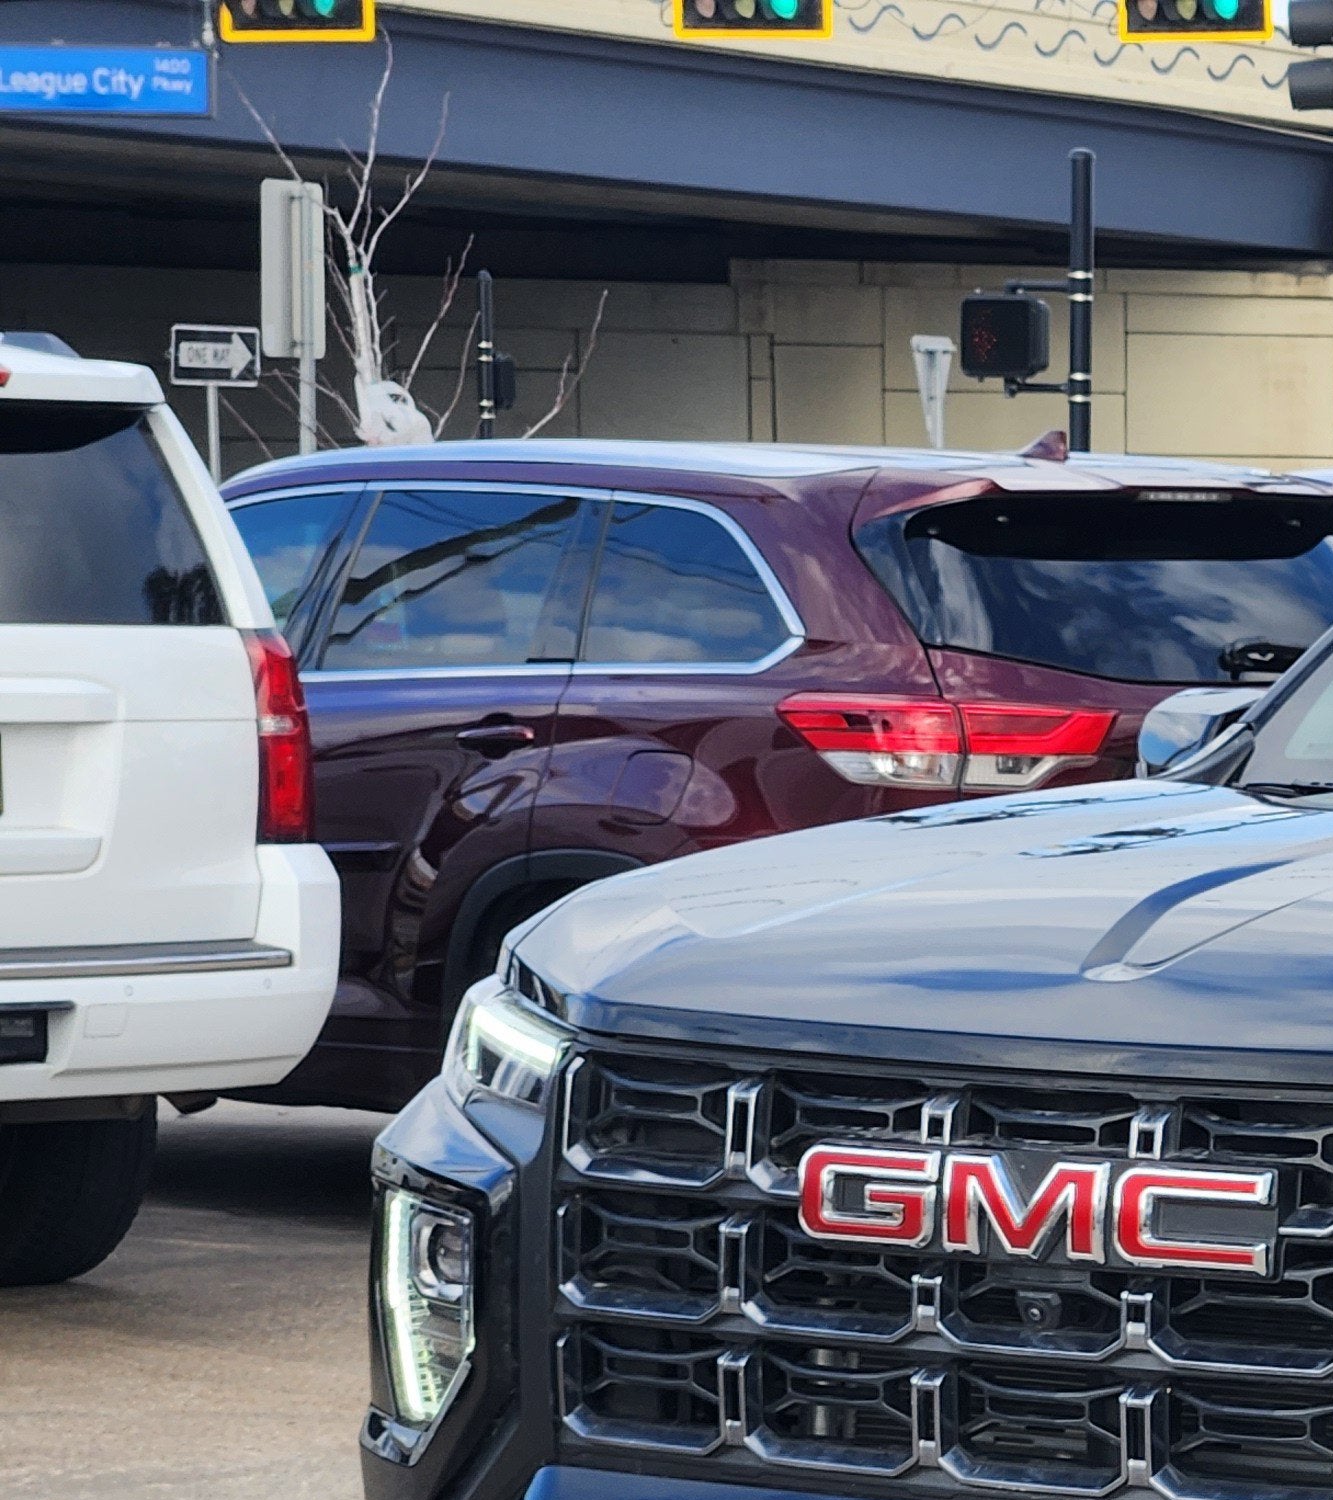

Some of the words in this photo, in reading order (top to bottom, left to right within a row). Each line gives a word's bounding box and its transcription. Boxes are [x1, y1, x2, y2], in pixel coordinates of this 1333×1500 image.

[0, 67, 88, 101] League
[92, 67, 145, 101] City
[798, 1144, 1274, 1277] GMC
